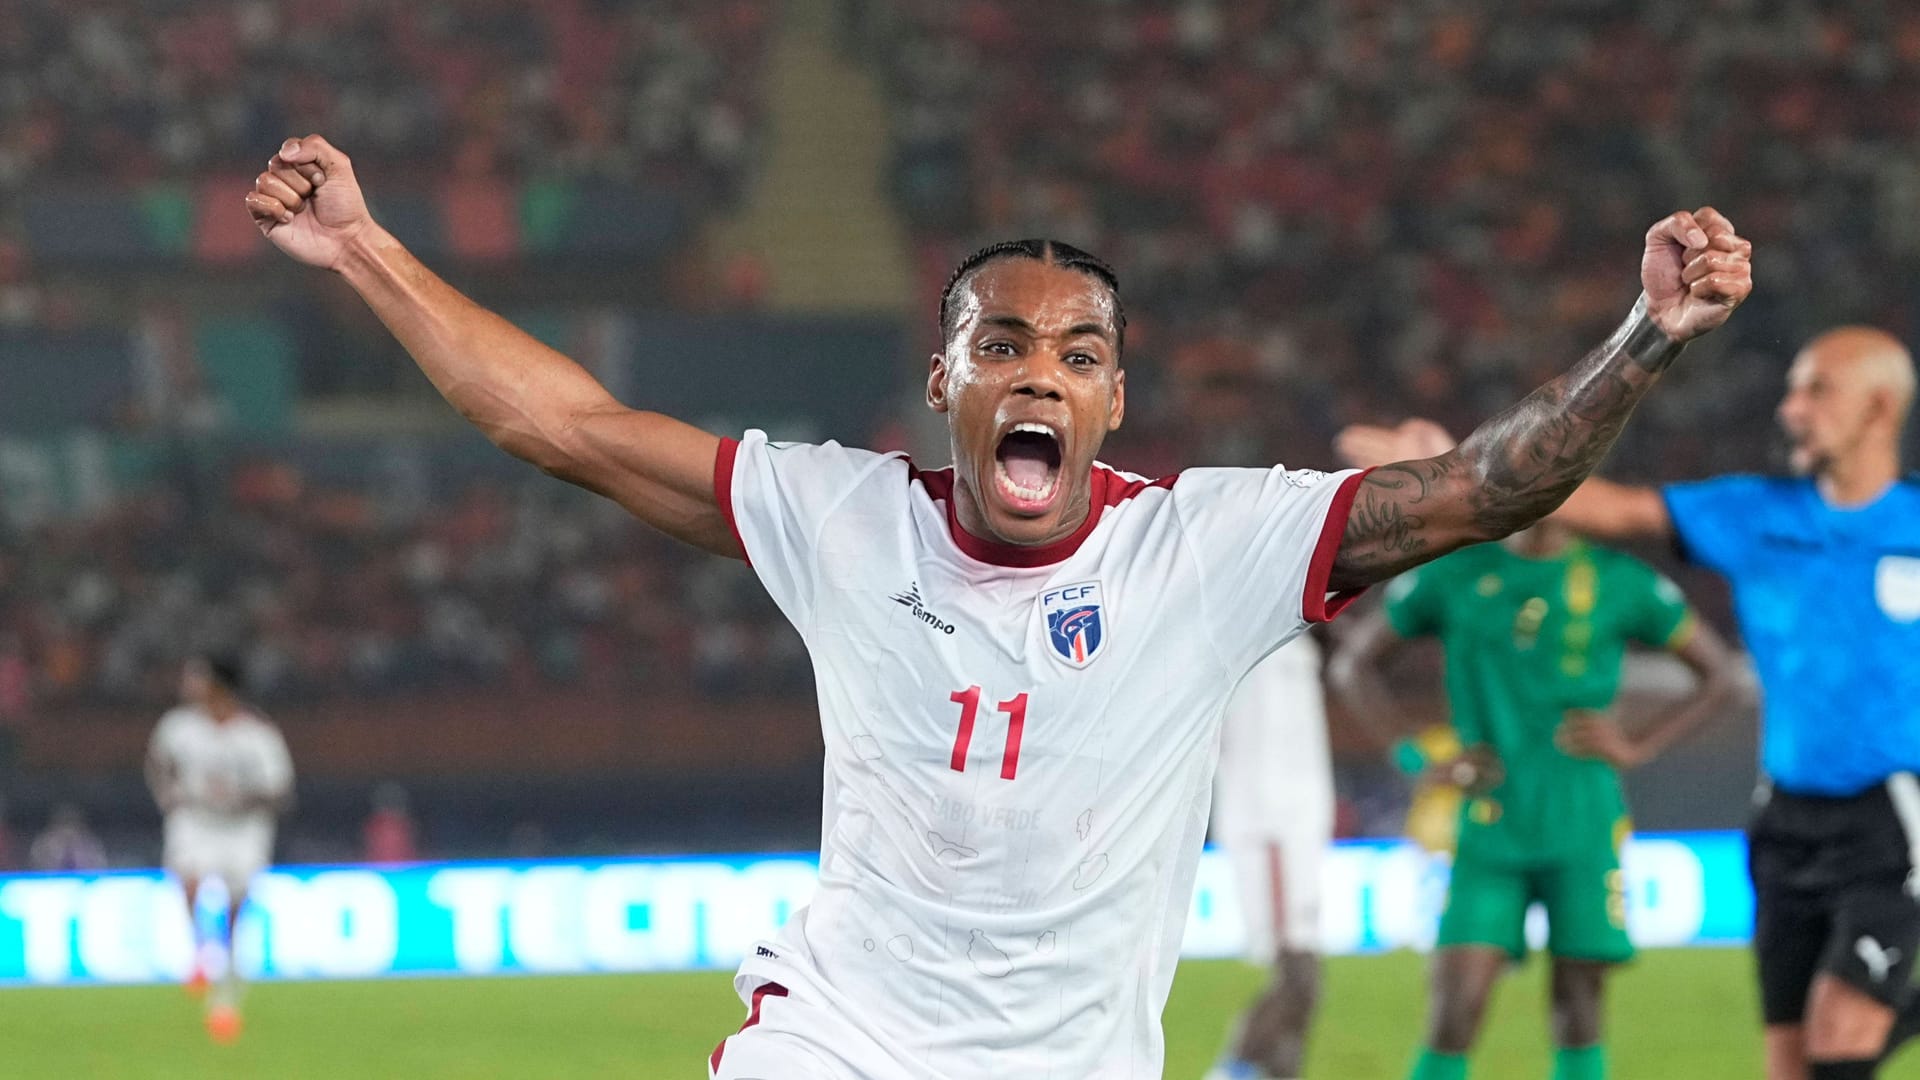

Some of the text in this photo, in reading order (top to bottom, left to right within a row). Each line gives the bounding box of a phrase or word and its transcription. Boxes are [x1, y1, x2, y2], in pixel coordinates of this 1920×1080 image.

[1044, 585, 1096, 606] FCF
[912, 604, 955, 635] tempo
[949, 684, 1029, 781] 11
[983, 804, 1044, 831] VERDE
[428, 862, 818, 973] TECNO
